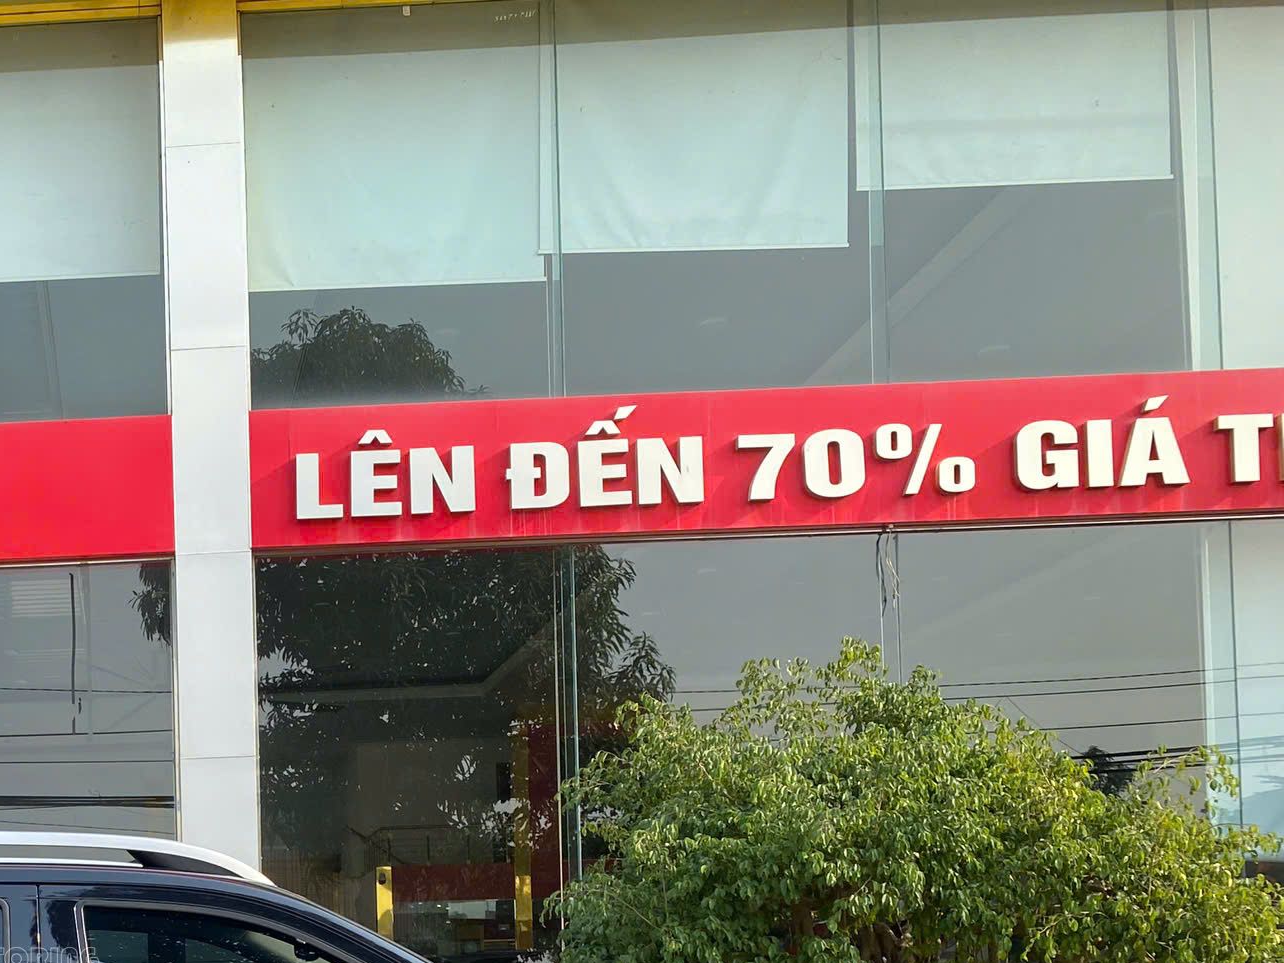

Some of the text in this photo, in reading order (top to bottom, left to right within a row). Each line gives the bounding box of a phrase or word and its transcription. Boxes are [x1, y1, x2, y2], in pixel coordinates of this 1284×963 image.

[295, 394, 1284, 520] LÊN ĐẾN 70% GIÁ T
